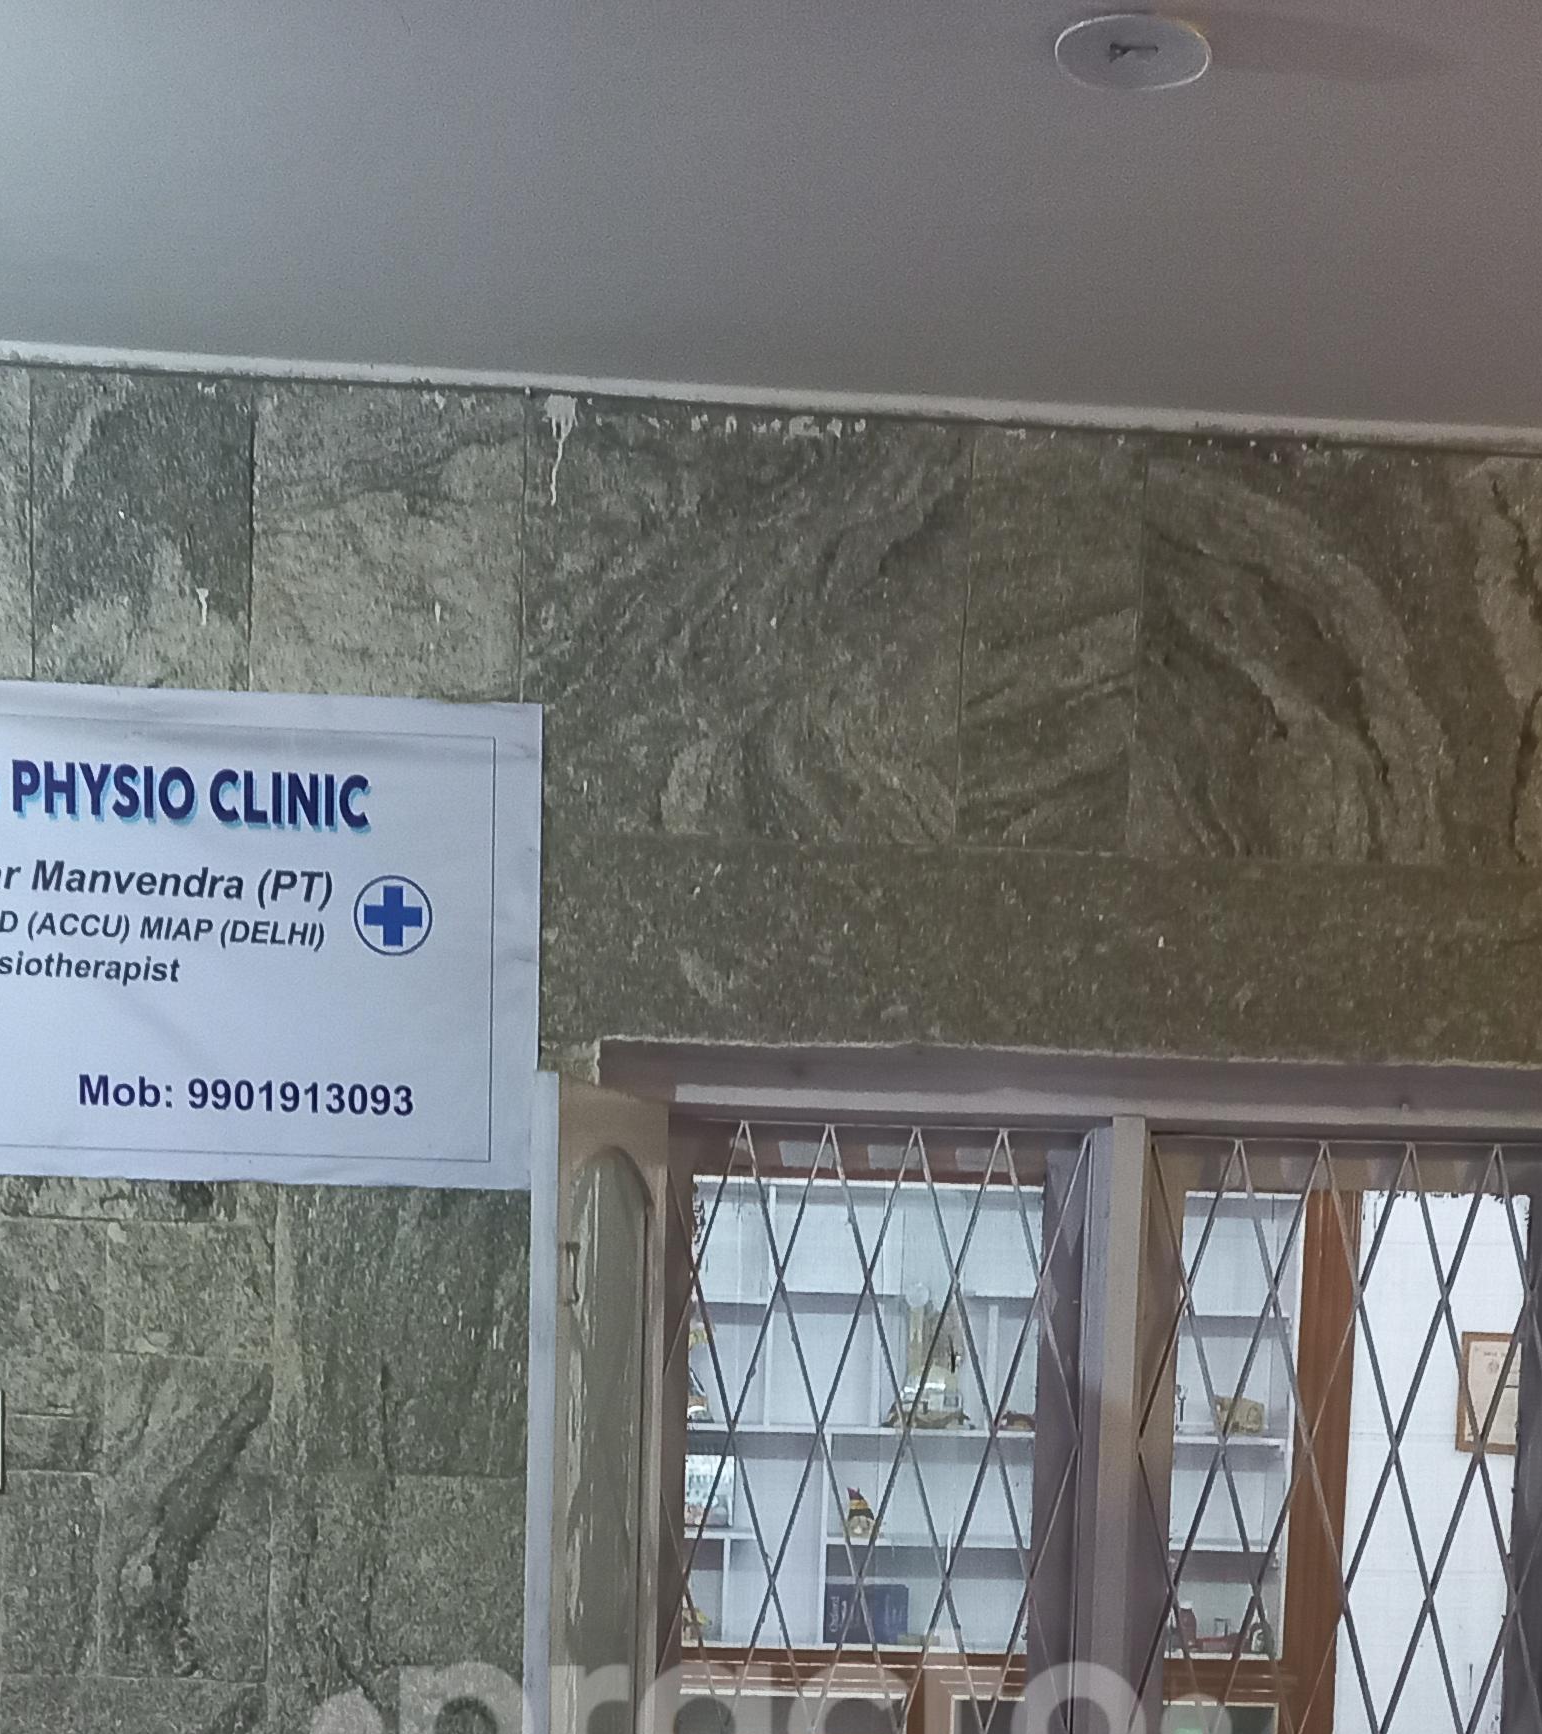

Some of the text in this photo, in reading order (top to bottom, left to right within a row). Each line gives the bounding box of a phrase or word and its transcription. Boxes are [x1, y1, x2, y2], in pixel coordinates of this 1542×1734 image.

[11, 759, 197, 824] PHYSIO
[209, 769, 372, 834] CLINIC
[31, 859, 244, 900] Manvendra
[258, 868, 333, 911] (PT)
[27, 911, 130, 944] (ACCU)
[140, 916, 214, 942] MIAP
[220, 919, 325, 952] (DELHI)
[78, 1074, 414, 1116] Mob: 9901913093
